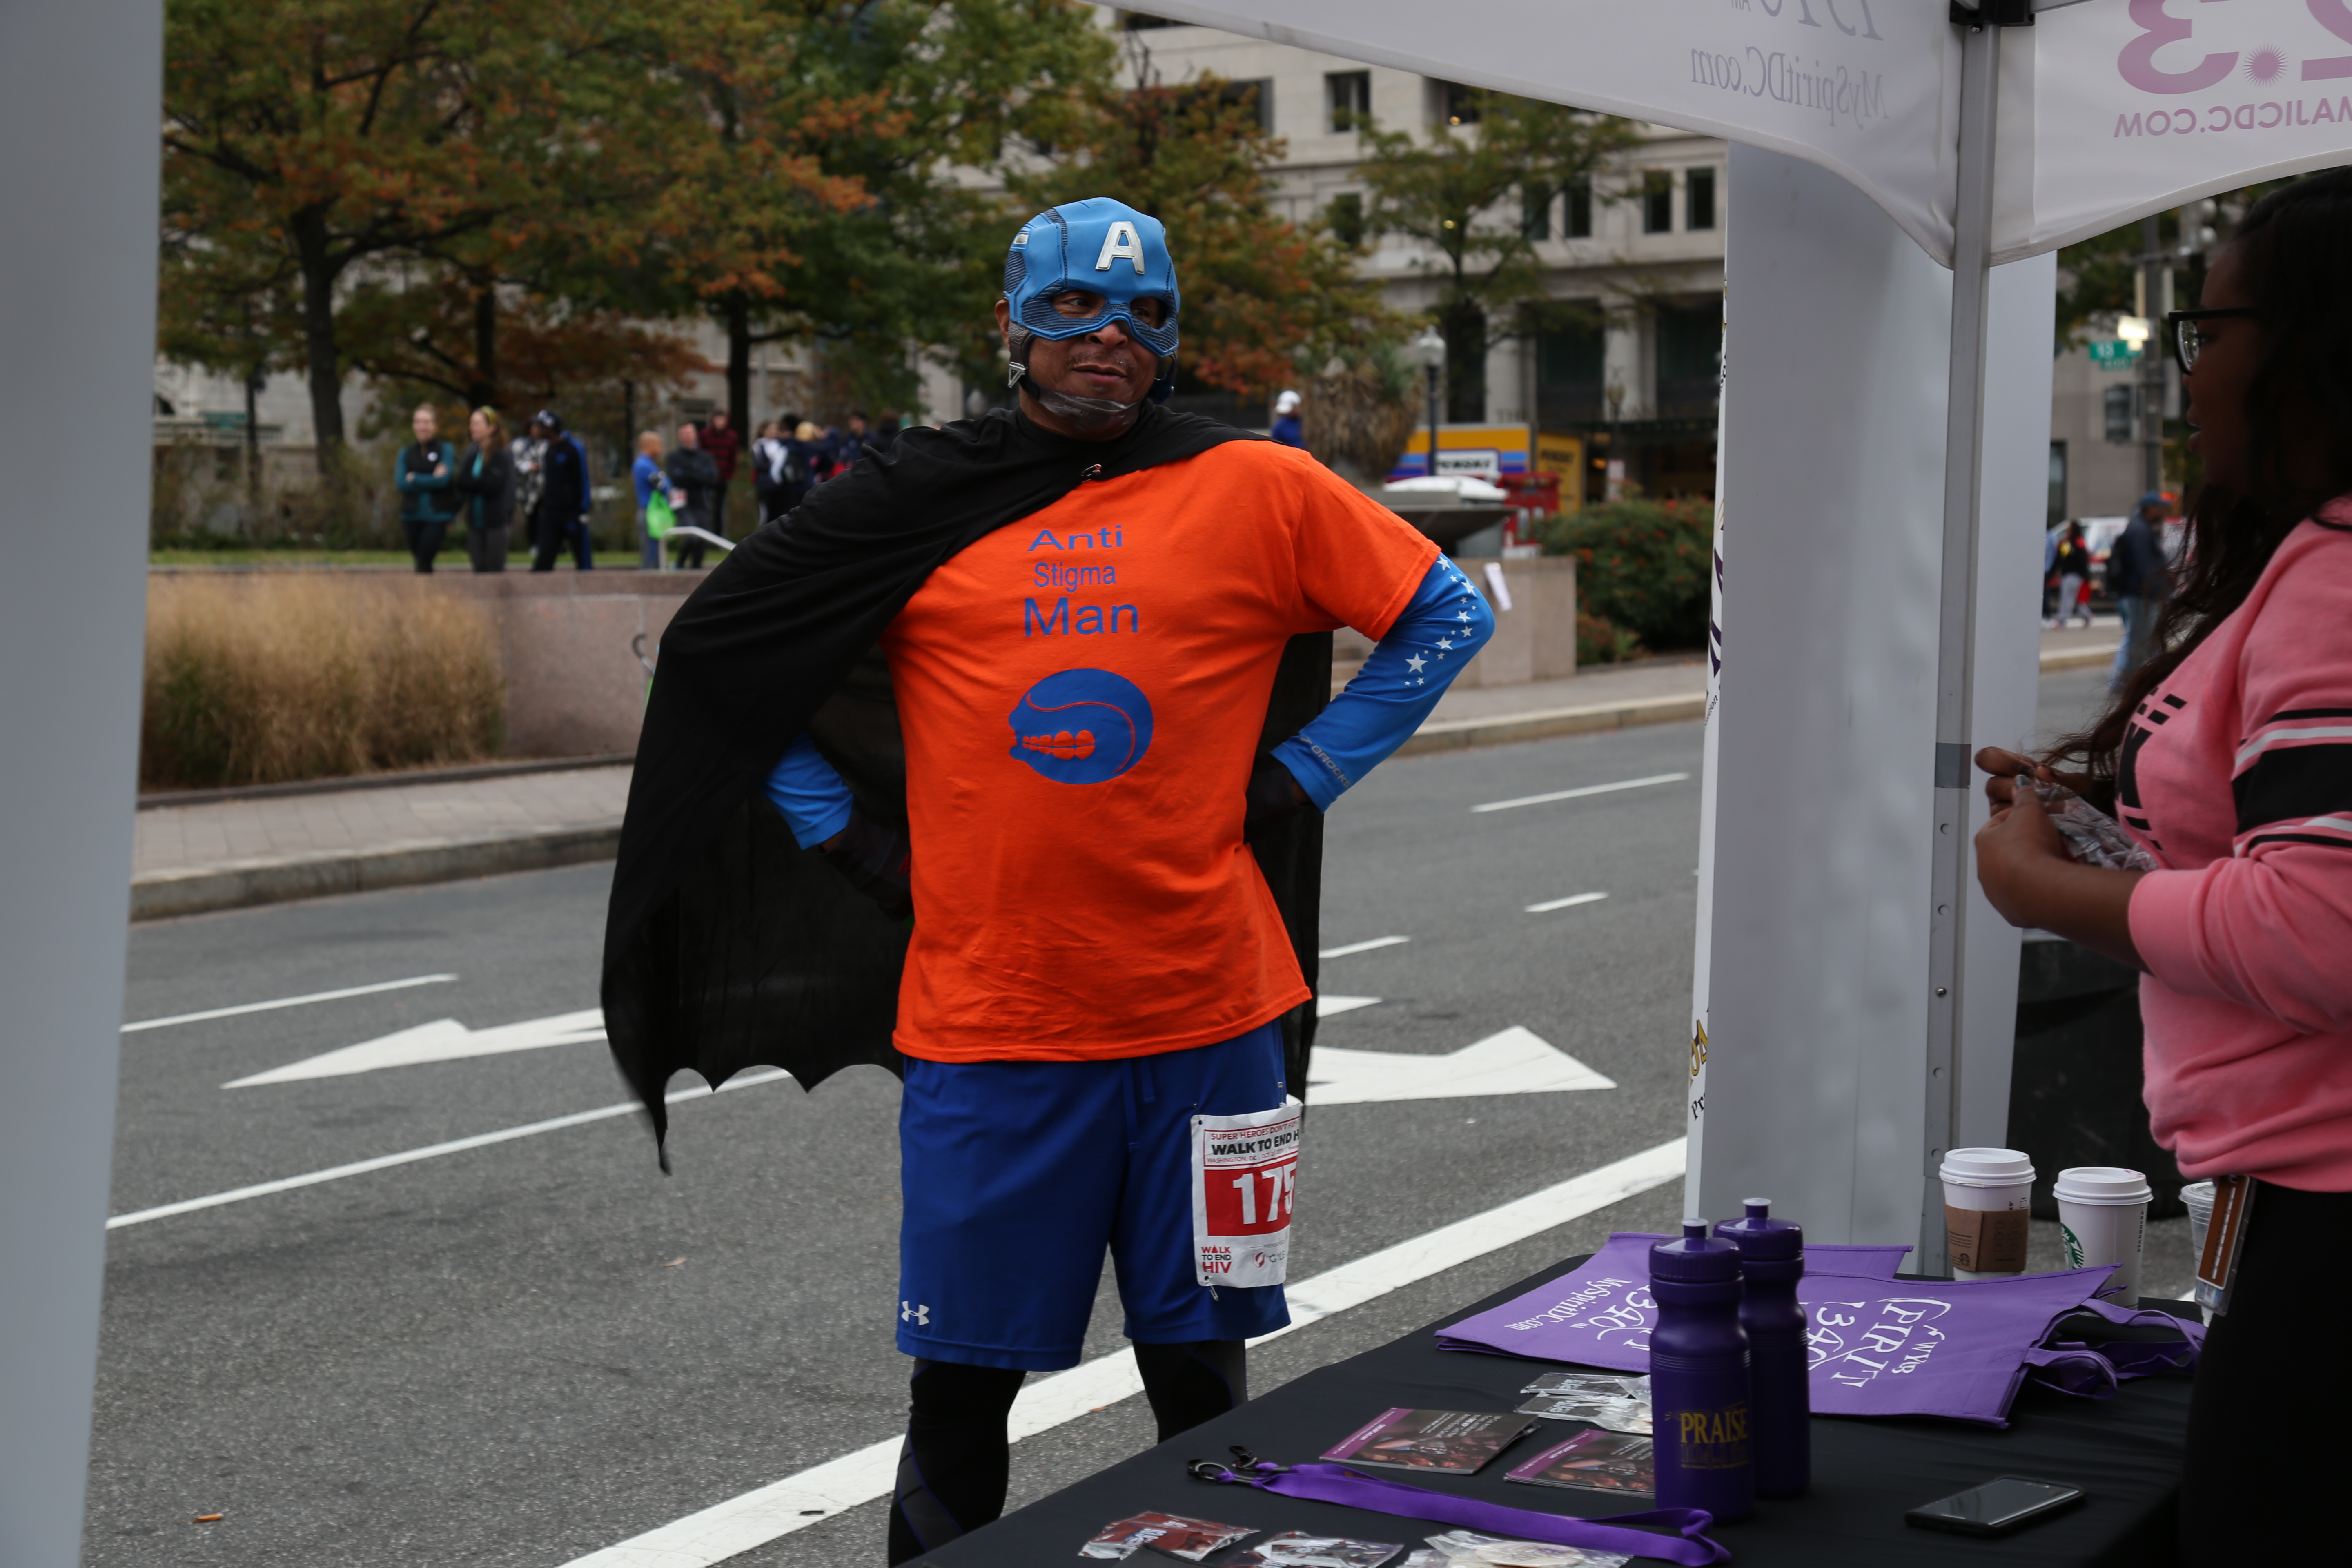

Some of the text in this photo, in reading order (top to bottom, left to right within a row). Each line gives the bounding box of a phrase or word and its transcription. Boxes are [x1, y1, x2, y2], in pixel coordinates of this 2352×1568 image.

[1095, 220, 1145, 274] A
[1027, 524, 1123, 552] Anti
[1033, 562, 1116, 593] Stigma
[1024, 597, 1138, 637] Man
[1310, 744, 1350, 788] BROOKS
[1211, 1142, 1256, 1155] WALK
[1257, 1138, 1272, 1152] TO
[1274, 1132, 1292, 1148] END
[1240, 1128, 1269, 1138] HEROES
[1270, 1123, 1288, 1134] DON'T
[1201, 1245, 1232, 1254] WALK
[1202, 1262, 1233, 1274] HIV
[1503, 1276, 1633, 1332] MySpiritDC.com
[1891, 1341, 1939, 1375] WYCB
[1680, 1408, 1748, 1444] PRAISE
